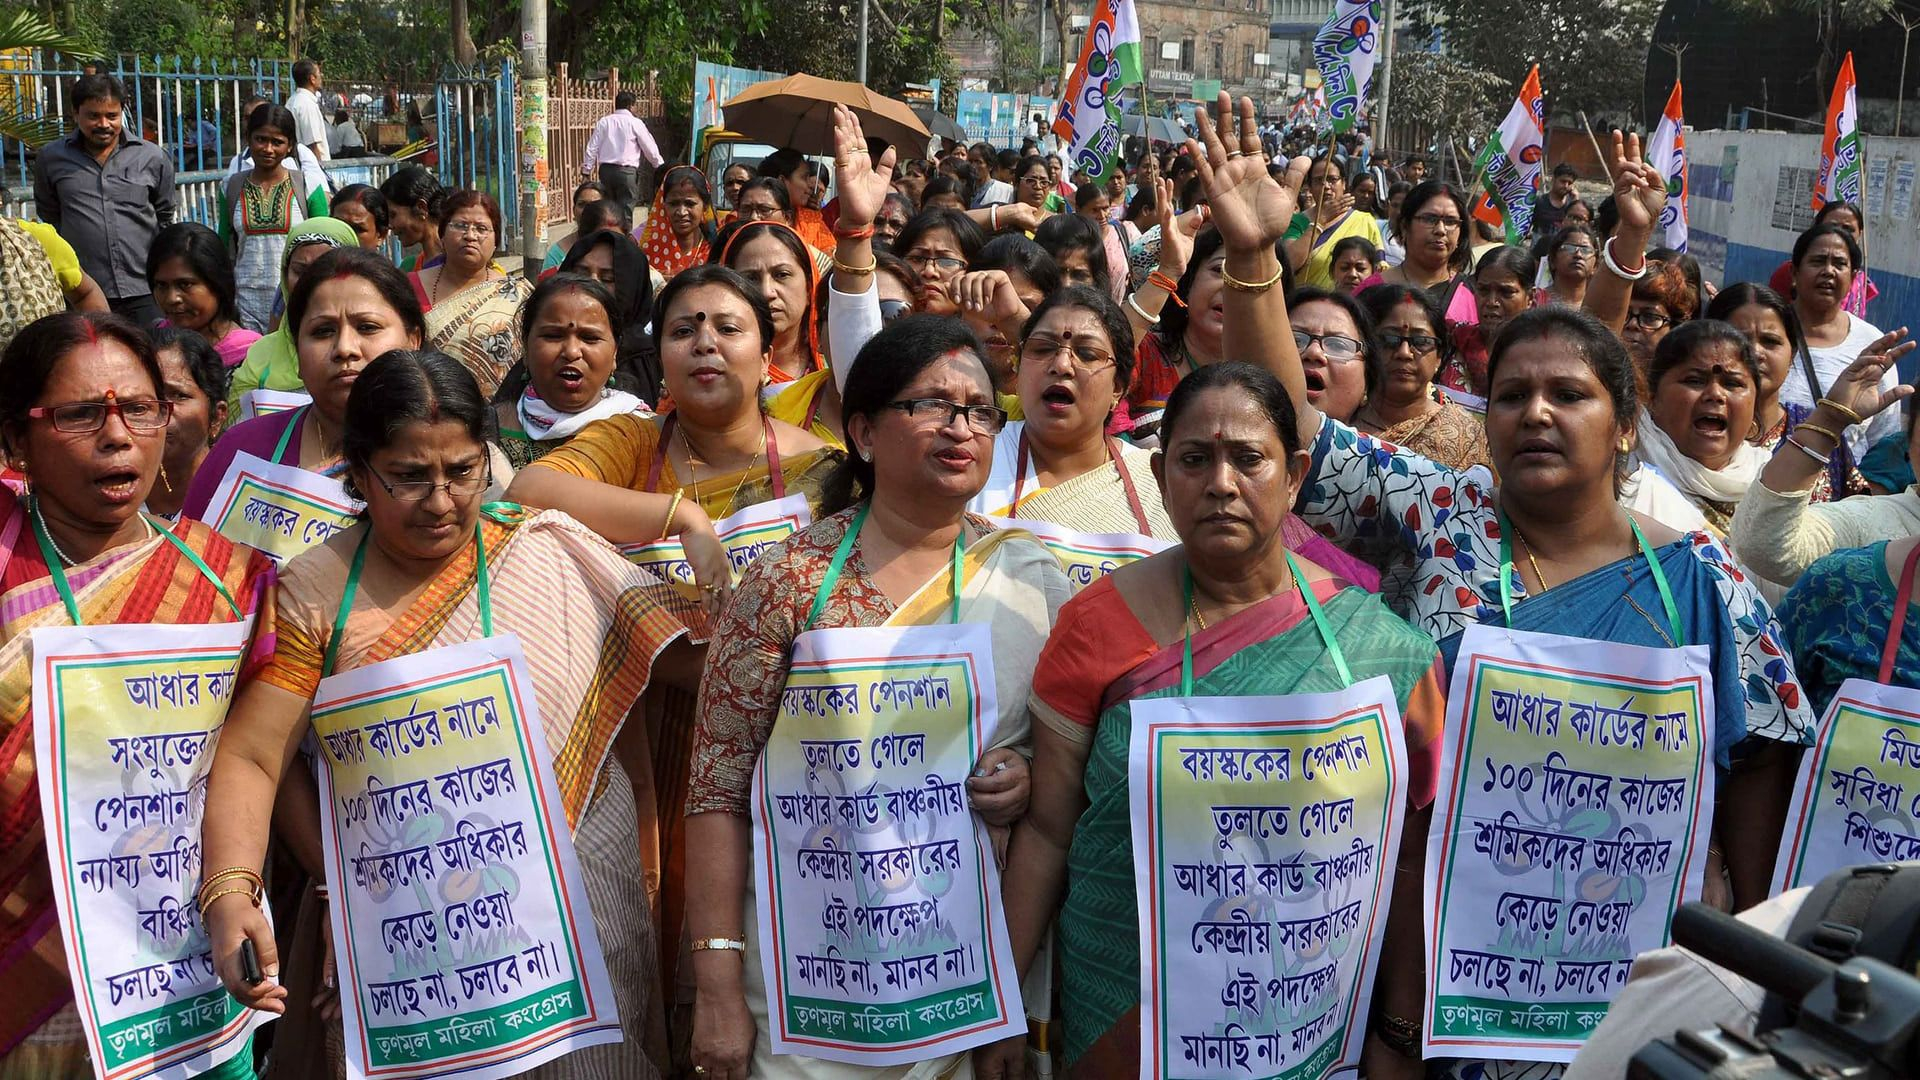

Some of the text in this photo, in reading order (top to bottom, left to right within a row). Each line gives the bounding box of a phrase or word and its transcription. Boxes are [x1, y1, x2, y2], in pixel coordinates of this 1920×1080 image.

[125, 671, 199, 710] আধার
[870, 675, 951, 713] পেনশান
[364, 698, 442, 758] কার্ডের
[443, 696, 500, 739] নামে
[1491, 688, 1690, 753] আধার কার্ডের নামে
[800, 732, 925, 780] তুলতে গেলে
[1302, 735, 1370, 781] পেনশান
[367, 775, 434, 825] দিনের
[434, 758, 516, 807] কাজের
[776, 789, 832, 828] আধার
[835, 779, 879, 833] কার্ড
[1483, 750, 1687, 816] ১০০ দিনের কাজের
[1830, 767, 1904, 814] সুবিধা
[1211, 798, 1355, 849] তুলতে গেলে
[1473, 811, 1672, 876] শ্রমিকদের অধিকার
[350, 819, 529, 892] শ্রমিকদের অধিকার
[797, 836, 960, 884] কেন্দ্রীয় সরকারের
[1173, 859, 1246, 898] আধার
[1254, 851, 1305, 897] কার্ড
[381, 887, 513, 954] কেড়ে নেওয়া
[822, 895, 940, 941] এই পদক্ষেপ
[1191, 900, 1362, 955] কেন্দ্রীয় সরকারের
[1496, 891, 1633, 942] কেড়ে নেওয়া
[105, 962, 176, 1007] চলছে
[368, 976, 429, 1019] চলছে
[457, 954, 520, 1001] চলবে
[796, 945, 849, 995] মানছি
[883, 952, 939, 995] মানব
[1221, 960, 1339, 1016] এই পদক্ষেপ
[1449, 948, 1515, 998] চলছে
[1554, 960, 1612, 994] চলবে
[107, 1012, 171, 1061] তৃণমূল
[375, 991, 574, 1061] তৃণমূল মহিলা কংগ্রেস
[793, 991, 985, 1037] তৃণমূল মহিলা কংগ্রেস
[1442, 1004, 1502, 1034] তৃণমূল
[1511, 1003, 1570, 1031] মহিলা
[1180, 1023, 1252, 1074] মানছি
